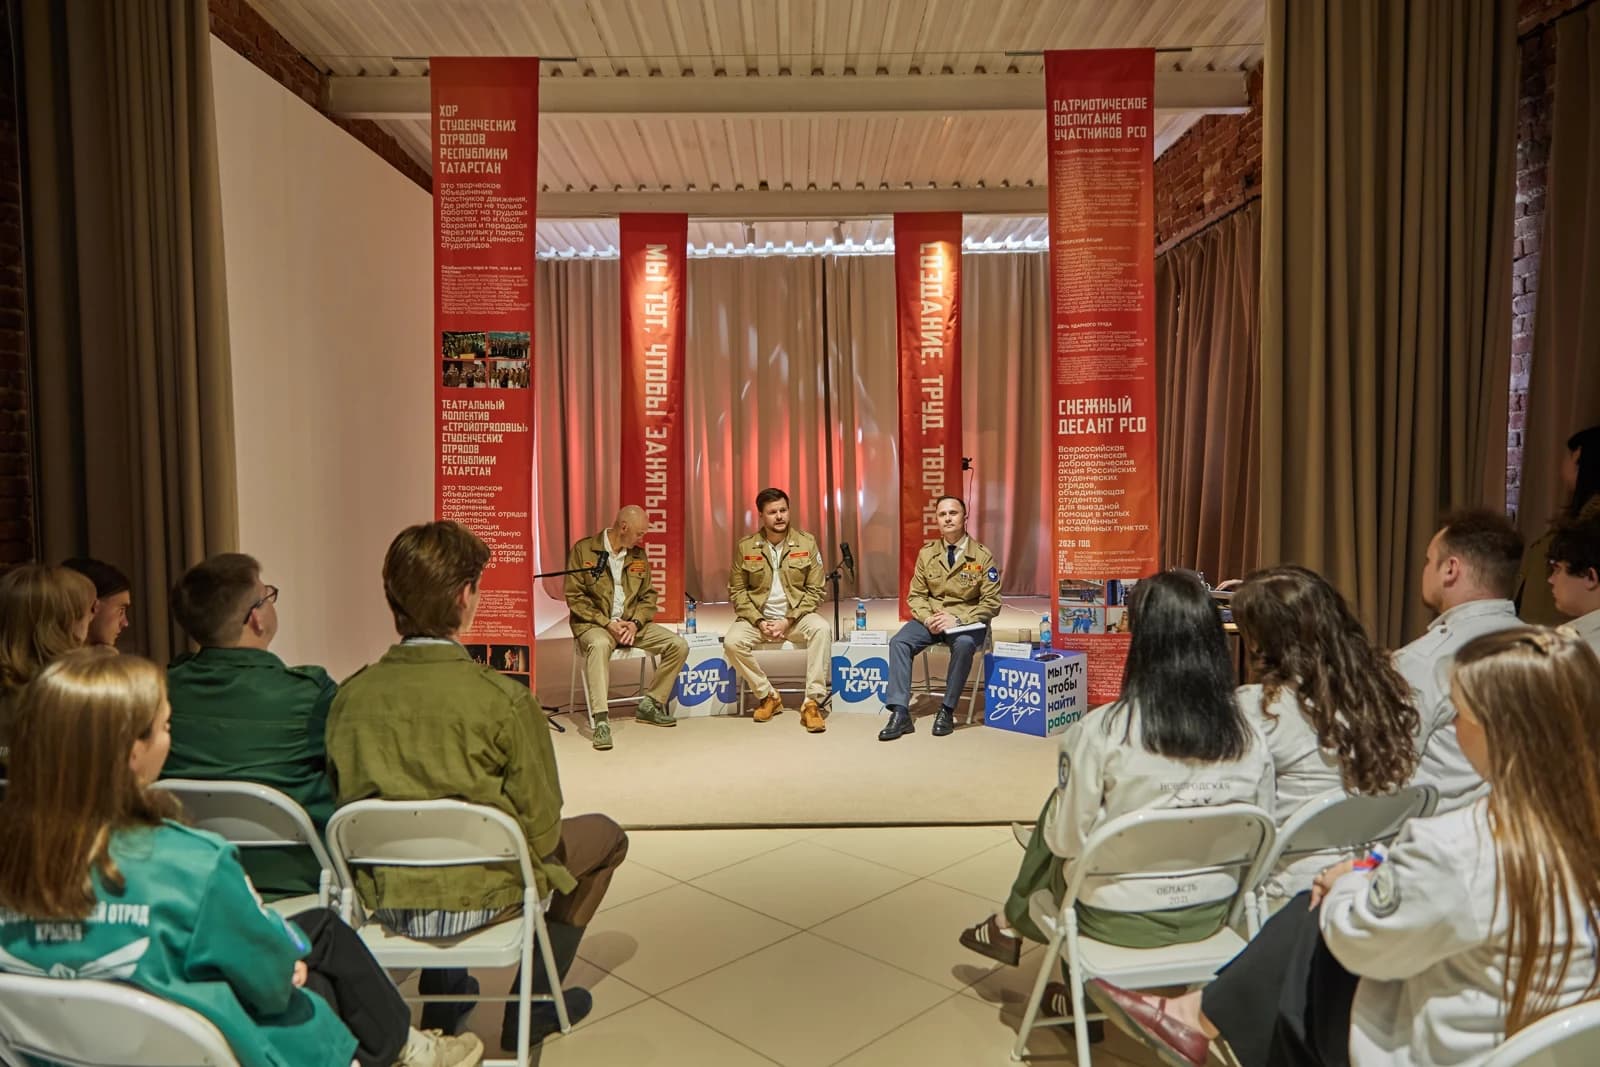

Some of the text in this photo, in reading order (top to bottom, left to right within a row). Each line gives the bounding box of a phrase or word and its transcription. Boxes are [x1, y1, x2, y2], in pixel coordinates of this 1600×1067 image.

[440, 104, 458, 116] ХОР
[1054, 98, 1148, 112] ПАТРИОТИЧЕСКОЕ
[440, 120, 516, 132] СТУДЕНЧЕСКИХ
[1054, 112, 1122, 126] ВОСПИТАНИЕ
[440, 133, 486, 145] ОТРЯДОВ
[1055, 126, 1147, 140] УЧАСТНИКОВ РСО
[440, 148, 508, 160] РЕСПУБЛИКИ
[440, 162, 501, 174] ТАТАРСТАН
[645, 244, 668, 282] МЫ
[920, 242, 944, 366] СОЗДАНИЕ.
[643, 291, 668, 333] ТУТ,
[645, 344, 668, 416] ЧТОБЫ
[442, 398, 505, 410] ТЕАТРАЛЬНЫЙ
[921, 374, 944, 435] ТРУД.
[1058, 396, 1132, 415] СНЕЖНЫЙ
[442, 411, 490, 421] КОЛЛЕКТИВ
[1058, 416, 1147, 435] ДЕСАНТ РСО
[442, 434, 503, 443] СТУДЕНЧЕСКИХ
[442, 444, 479, 454] ОТРЯДОВ
[1058, 444, 1124, 454] Всероссийская
[442, 456, 496, 465] РЕСПУБЛИКИ
[1058, 453, 1127, 461] патриотическая
[1058, 460, 1135, 468] добровольческая
[442, 466, 491, 476] ТАТАРСТАН
[645, 427, 667, 533] ЗАНЯТЬСЯ
[679, 669, 720, 684] ТРУД
[839, 667, 881, 680] ТРУД
[1064, 663, 1082, 677] тут,
[683, 681, 729, 696] КРУТ
[845, 680, 888, 693] КРУТ
[1048, 678, 1077, 695] чтобы
[1048, 696, 1076, 712] найти
[1048, 711, 1081, 733] работу
[108, 903, 150, 928] ОТРЯД
